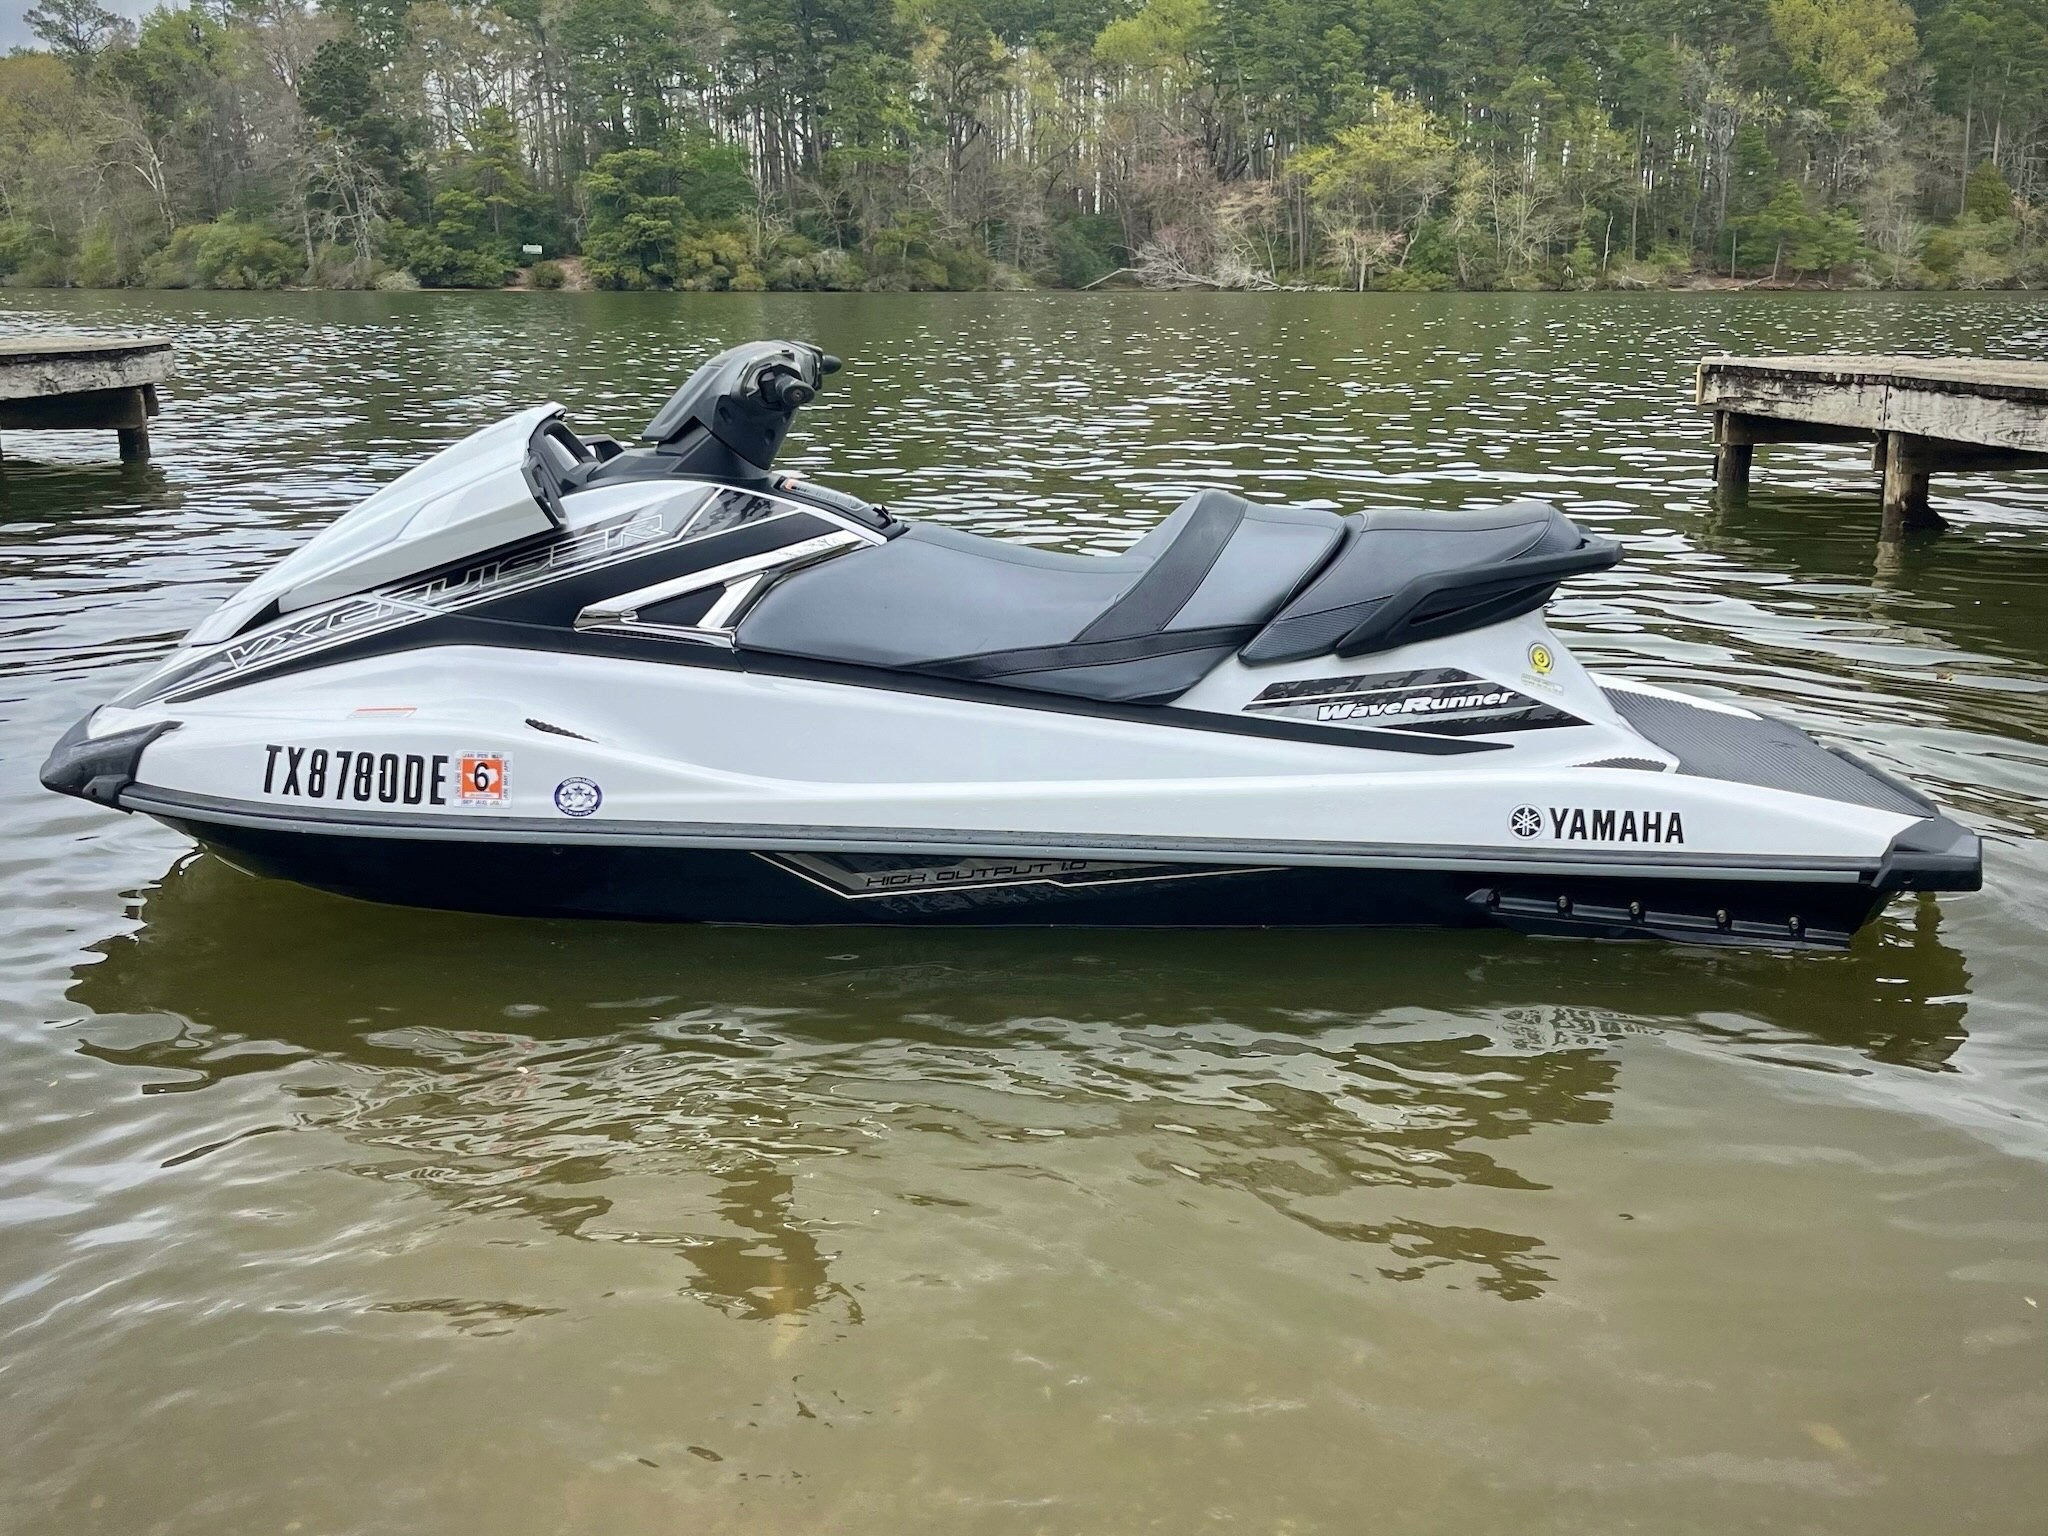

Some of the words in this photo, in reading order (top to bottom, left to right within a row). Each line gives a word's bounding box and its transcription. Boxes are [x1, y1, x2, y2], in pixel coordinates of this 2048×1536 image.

[1537, 652, 1545, 663] 3
[1317, 691, 1515, 721] WaveRunner
[474, 762, 489, 791] 6
[1549, 808, 1685, 844] YAMAHA
[866, 873, 927, 887] HIGH
[936, 863, 1052, 881] OUTPUT
